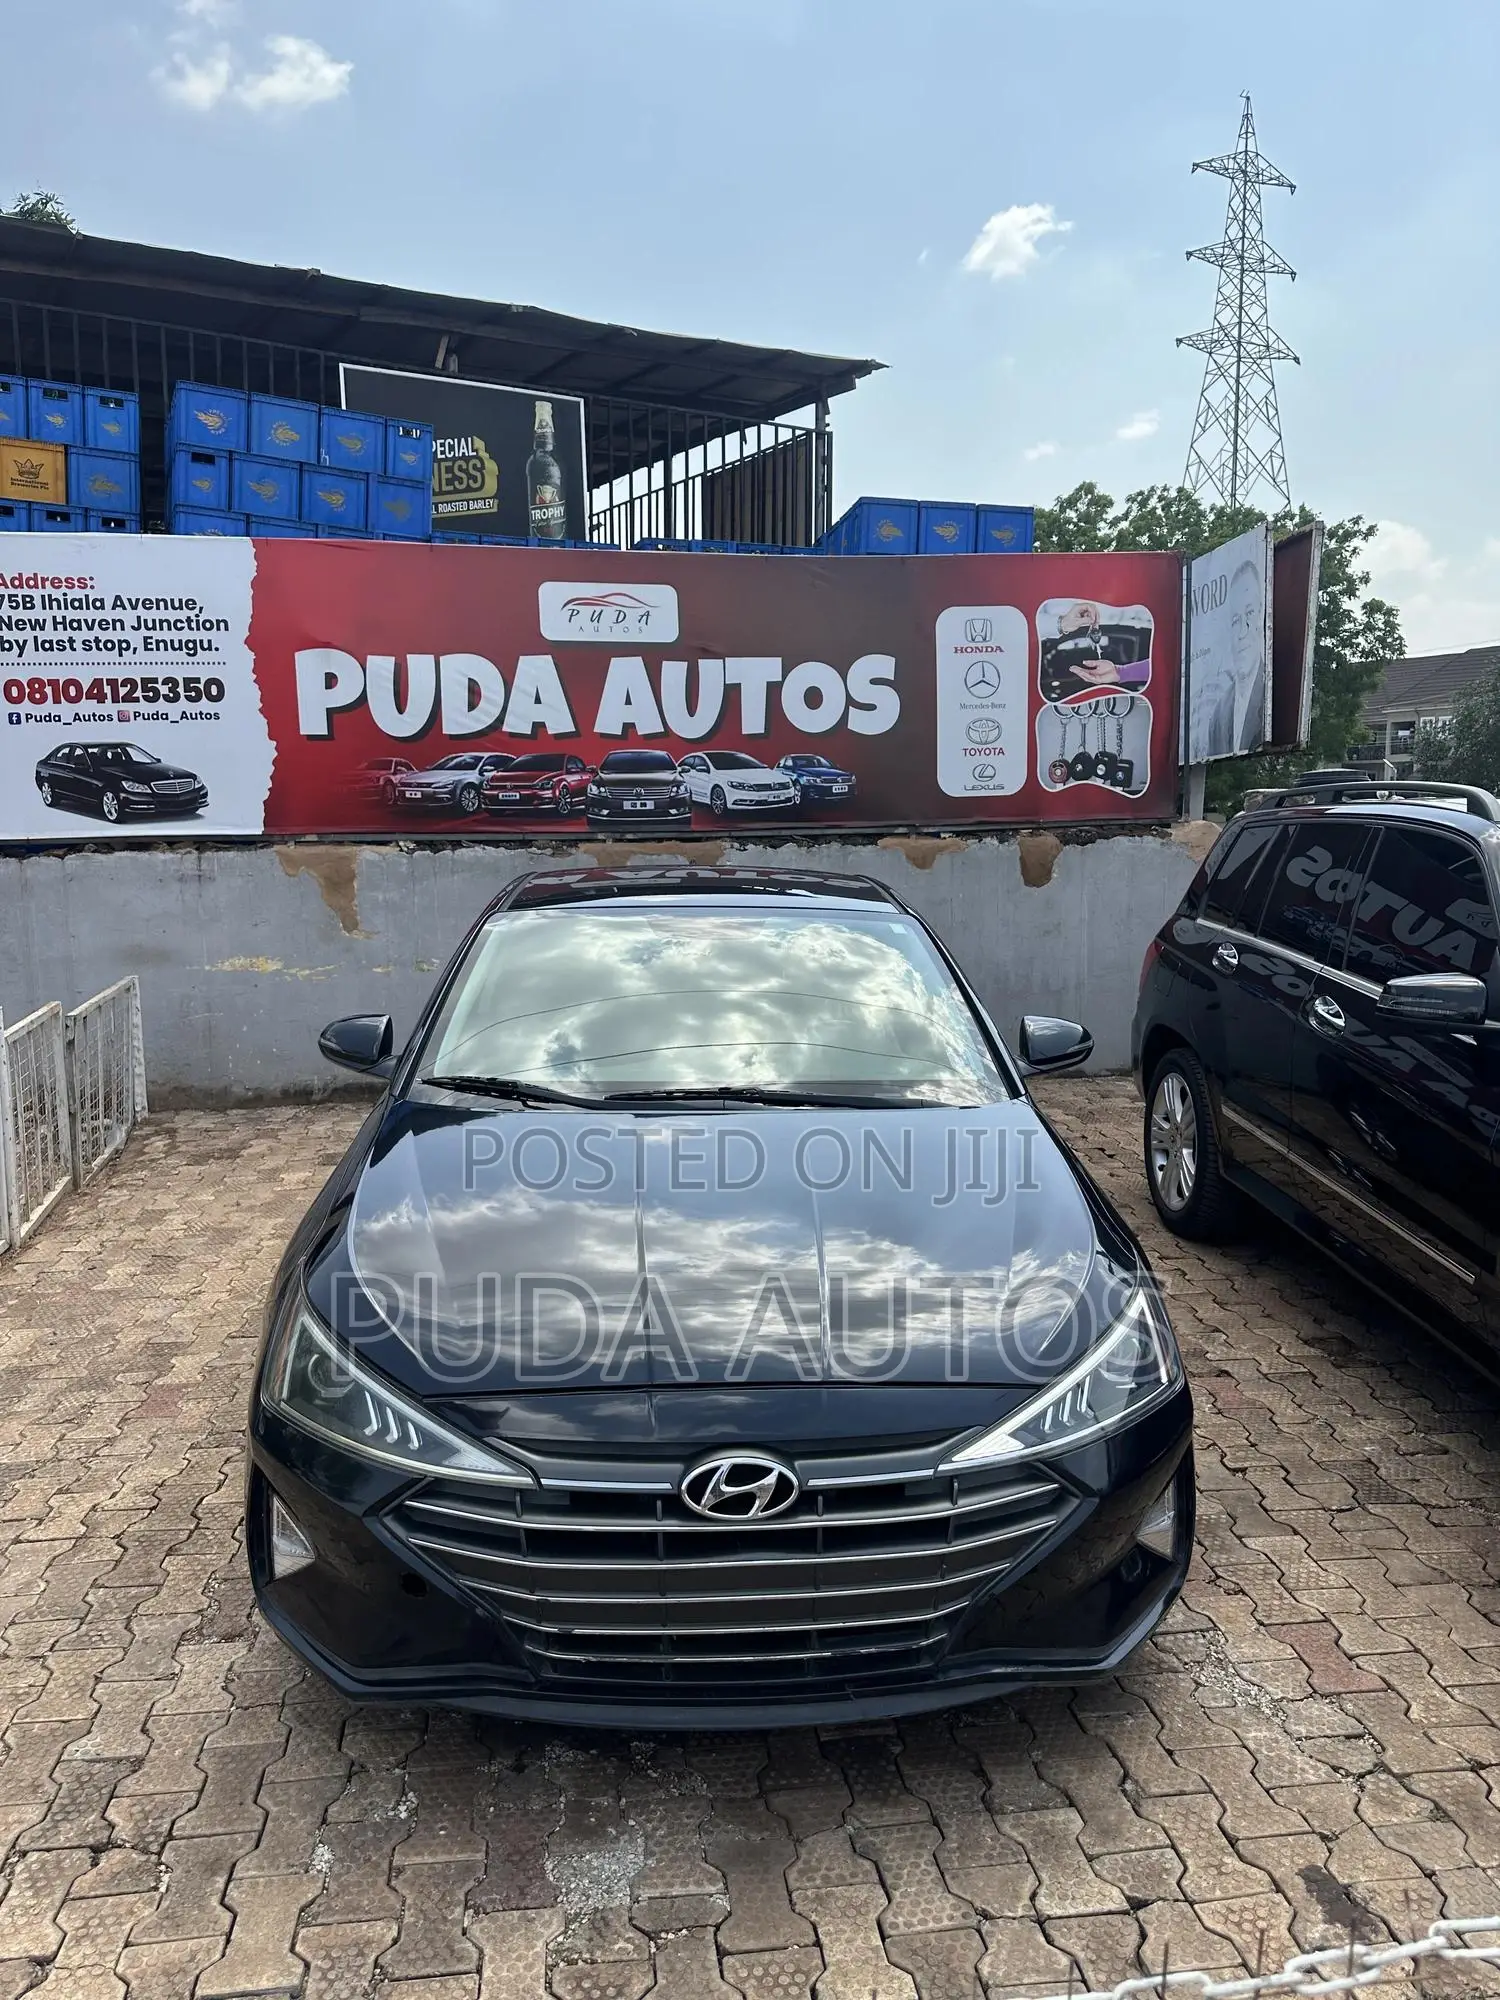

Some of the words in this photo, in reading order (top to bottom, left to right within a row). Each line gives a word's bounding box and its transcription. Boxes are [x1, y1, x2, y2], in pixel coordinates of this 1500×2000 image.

[438, 501, 468, 513] ROASTED
[469, 499, 494, 510] BARLEY
[531, 506, 565, 520] TROPHY
[0, 573, 95, 590] Address:
[41, 593, 106, 611] Ihiala
[111, 594, 204, 614] Avenue,
[0, 615, 46, 632] New
[53, 615, 125, 632] Haven
[131, 614, 229, 632] Junction
[567, 608, 651, 626] PUDA
[0, 636, 28, 658] by
[34, 636, 77, 652] last
[82, 637, 137, 657] stop,
[143, 636, 219, 656] Enugu.
[953, 645, 1004, 654] HONDA
[3, 676, 226, 705] 08104125350
[294, 648, 578, 738] PUDA
[593, 654, 901, 739] AUTOS
[959, 702, 1006, 710] Mercedes-Benz
[25, 712, 114, 726] Puda_Autos
[133, 710, 220, 724] Puda_Autos
[962, 747, 1005, 757] TOYOTA
